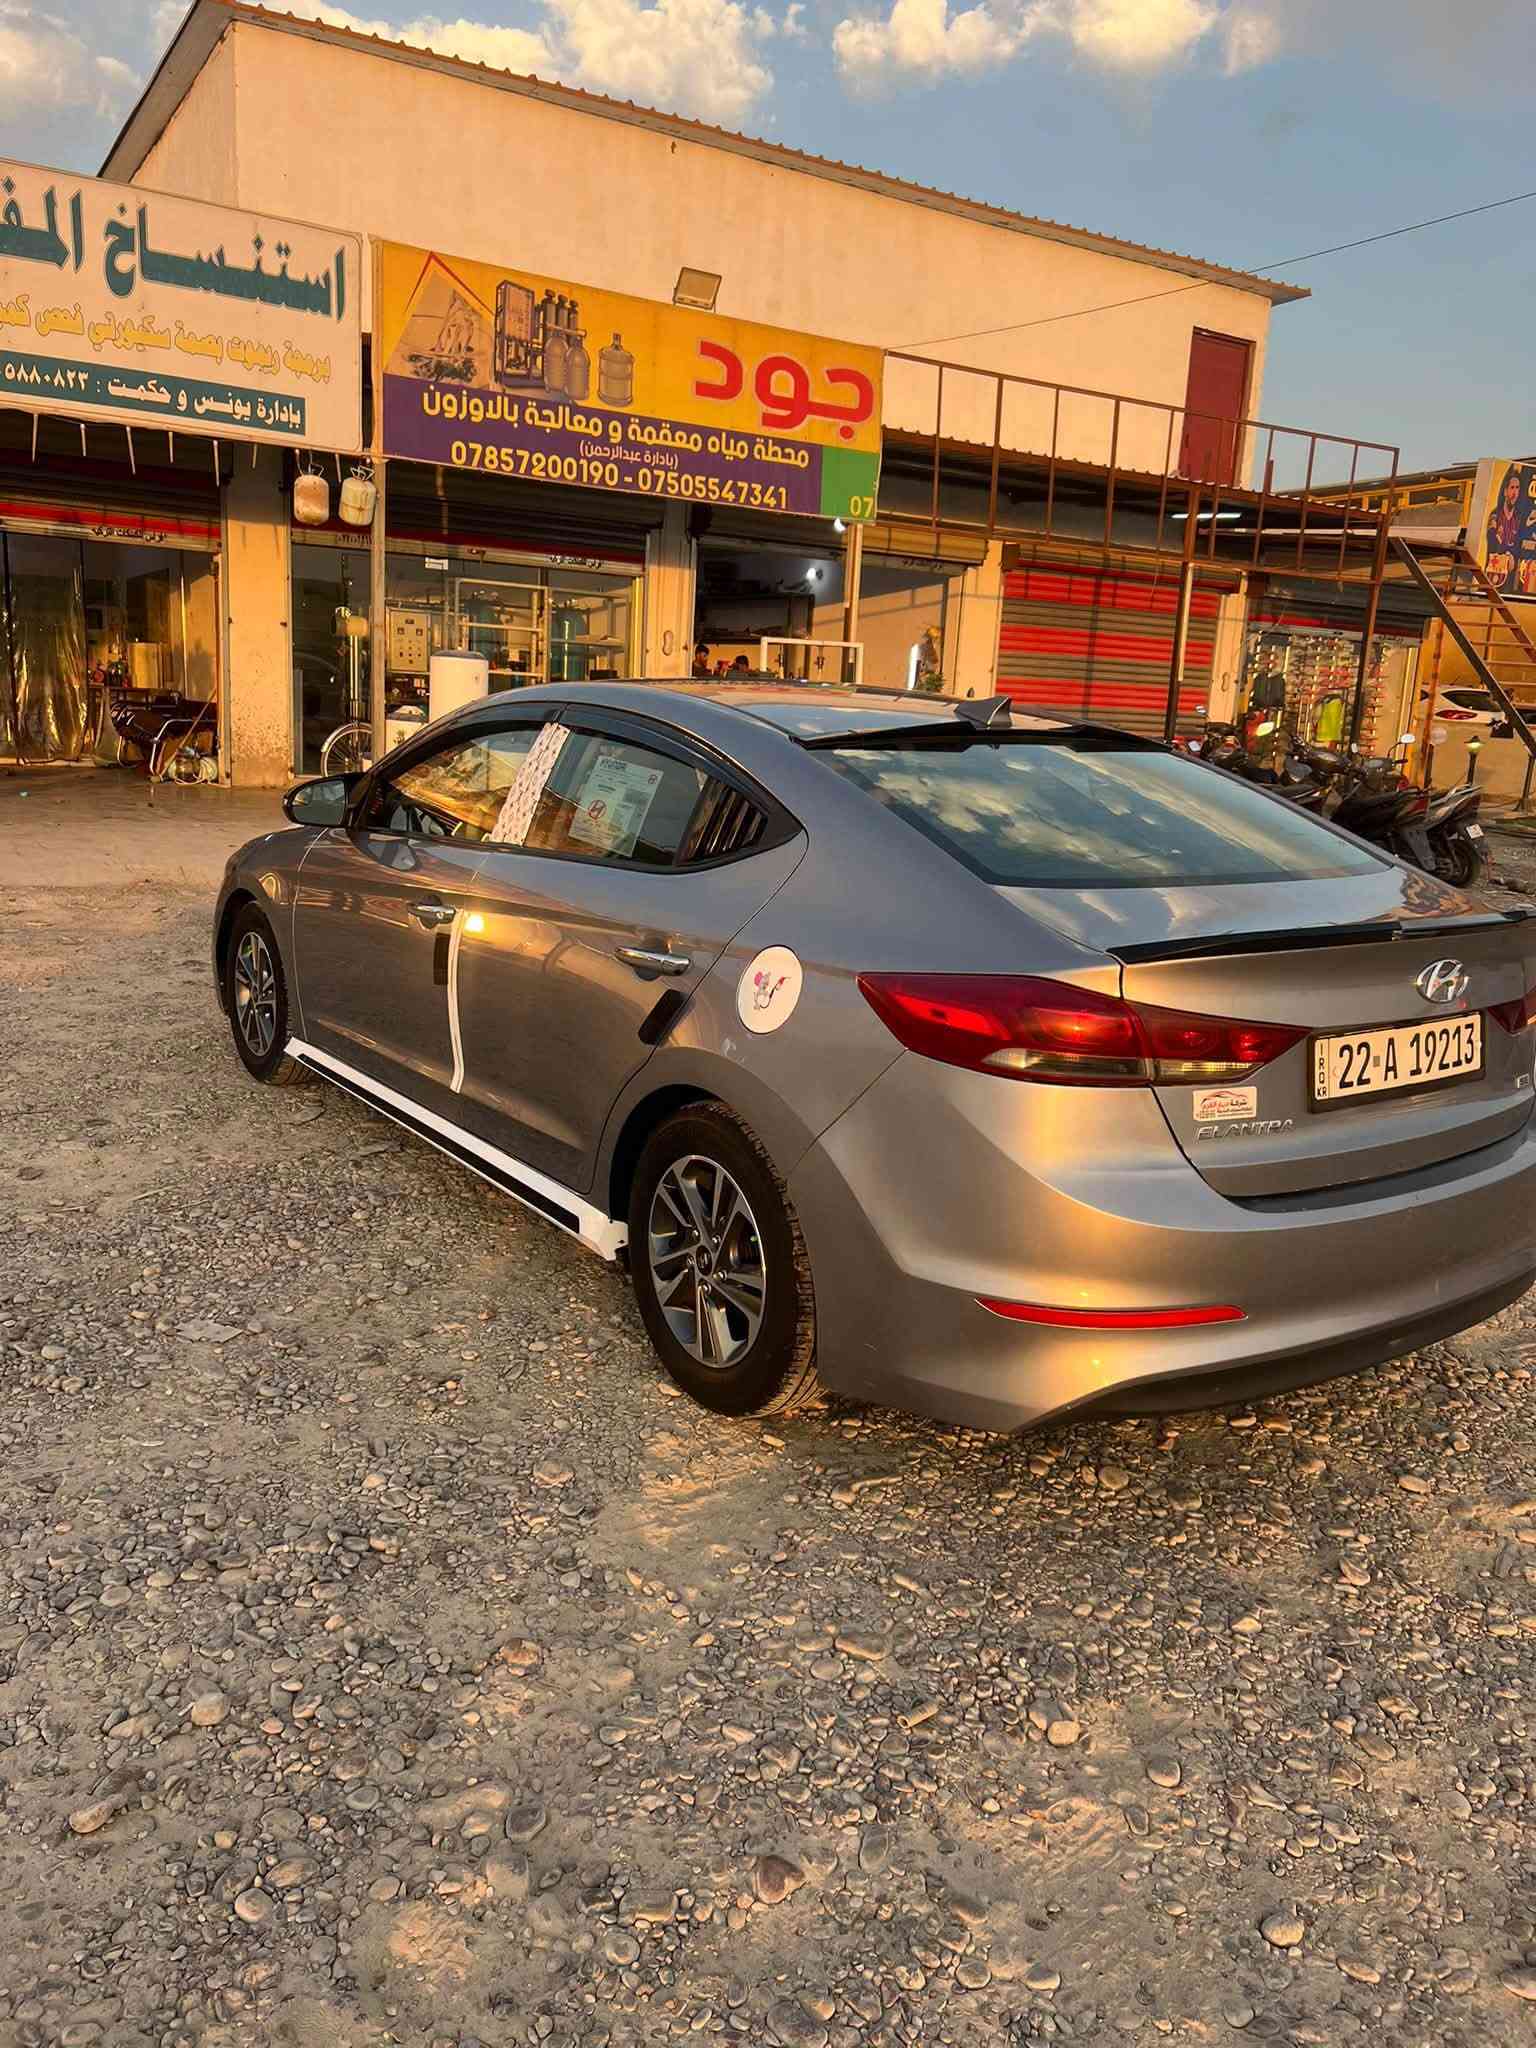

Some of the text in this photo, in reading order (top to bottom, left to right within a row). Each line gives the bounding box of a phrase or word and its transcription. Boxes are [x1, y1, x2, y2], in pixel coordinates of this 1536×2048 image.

[0, 175, 345, 320] استنساخ المف
[108, 380, 172, 405] حكمت
[176, 389, 189, 412] و
[194, 391, 252, 423] يونس
[257, 397, 302, 429] بإدارة
[694, 338, 875, 440] جود
[423, 384, 810, 469] محطة مياه معقمة و معالجة بالاوزون
[450, 440, 620, 488] 07857200190
[637, 470, 788, 511] 07505547341
[848, 495, 875, 518] 07
[1338, 1023, 1475, 1090] 22 A 19213
